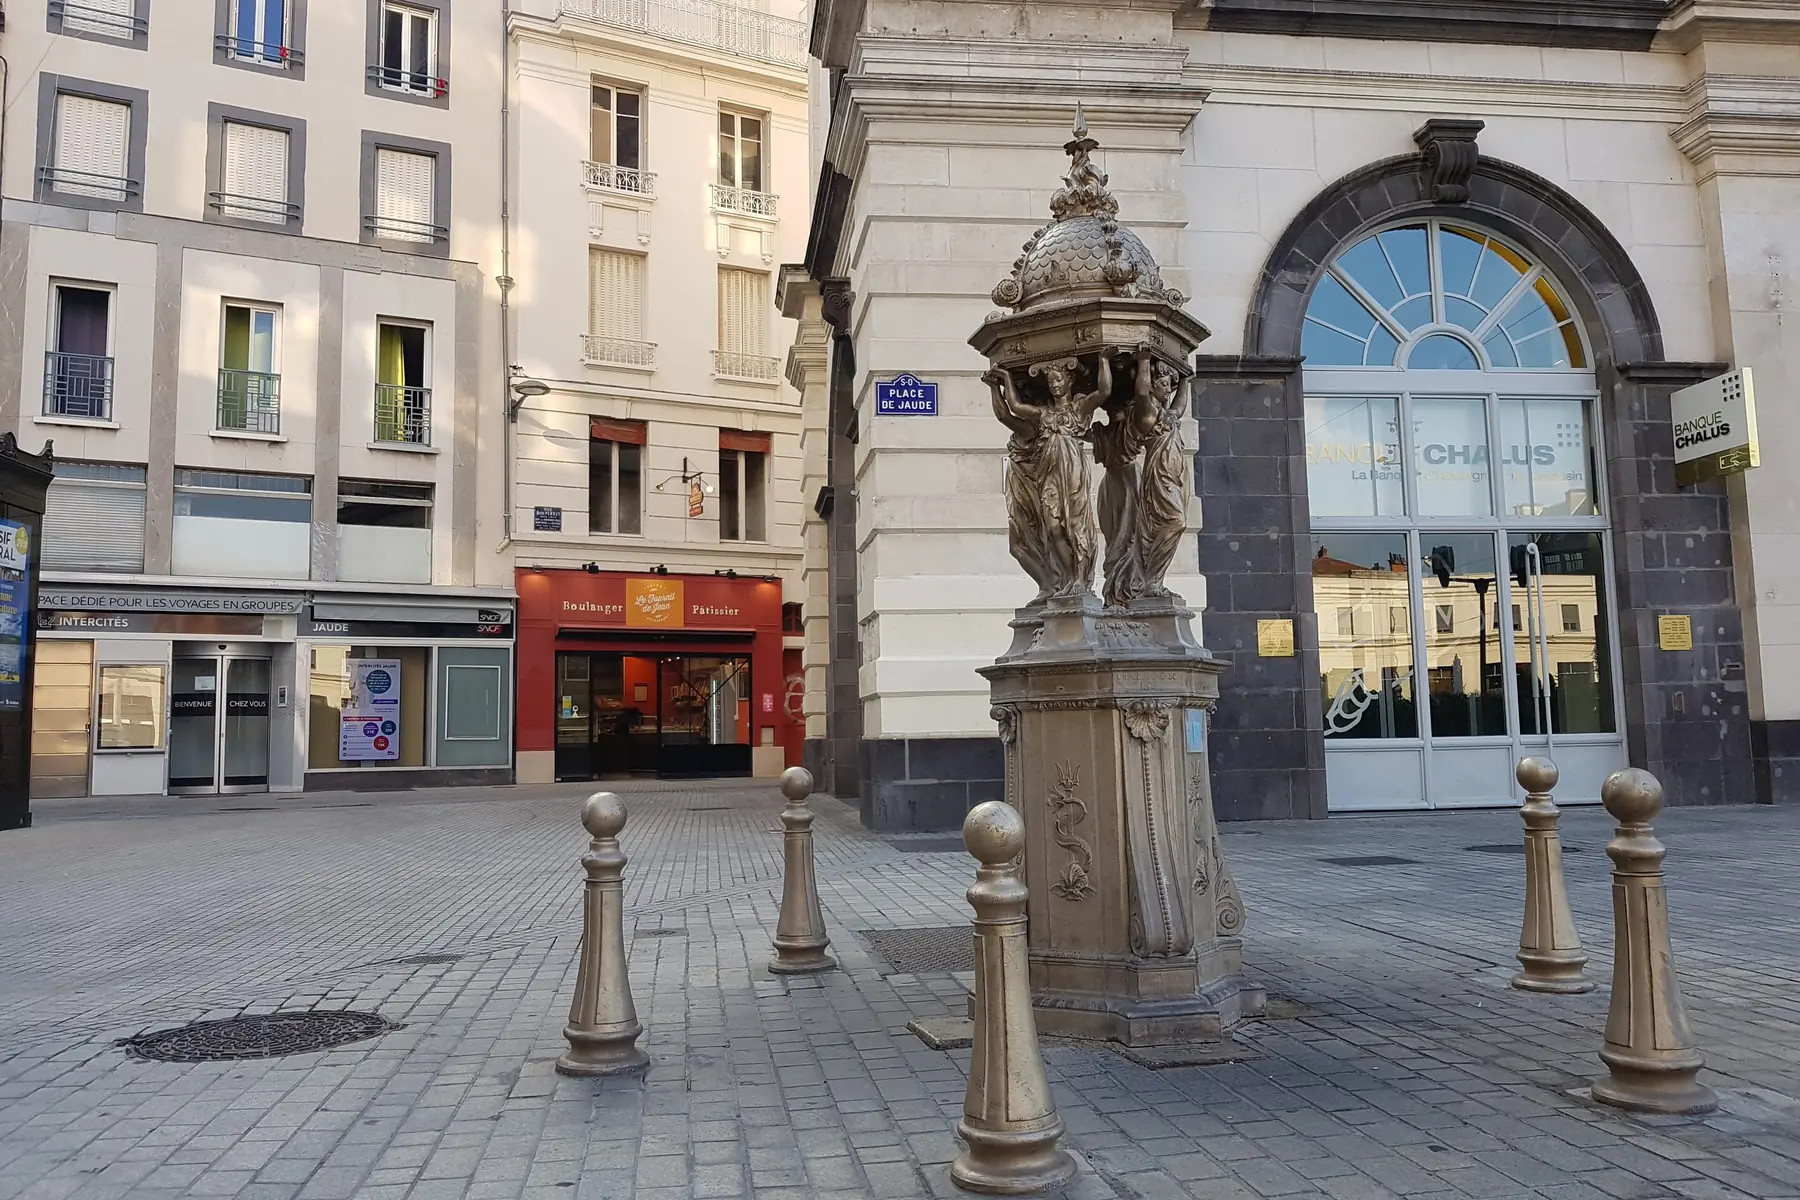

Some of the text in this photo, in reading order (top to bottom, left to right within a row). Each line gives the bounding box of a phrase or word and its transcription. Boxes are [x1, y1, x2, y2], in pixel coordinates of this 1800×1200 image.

[889, 389, 924, 398] PLACE
[881, 400, 933, 410] DE JAUDE
[1674, 411, 1723, 437] BANQUE
[1675, 423, 1730, 449] CHALUS
[1423, 444, 1556, 465] CHALUS
[1352, 469, 1367, 480] La
[71, 595, 106, 606] DÉDIÉ
[109, 597, 142, 607] POUR
[146, 598, 167, 607] LES
[168, 599, 220, 609] VOYAGES
[223, 600, 239, 609] EN
[241, 600, 294, 610] GROUPES
[563, 601, 624, 614] Boulanger
[692, 604, 739, 616] Pâtissier
[59, 616, 129, 627] INTERCITÉS
[479, 613, 500, 621] SNCF
[312, 623, 349, 632] JAUDE
[174, 700, 213, 708] BIENVENUE
[229, 700, 267, 708] CHEZ VOUS
